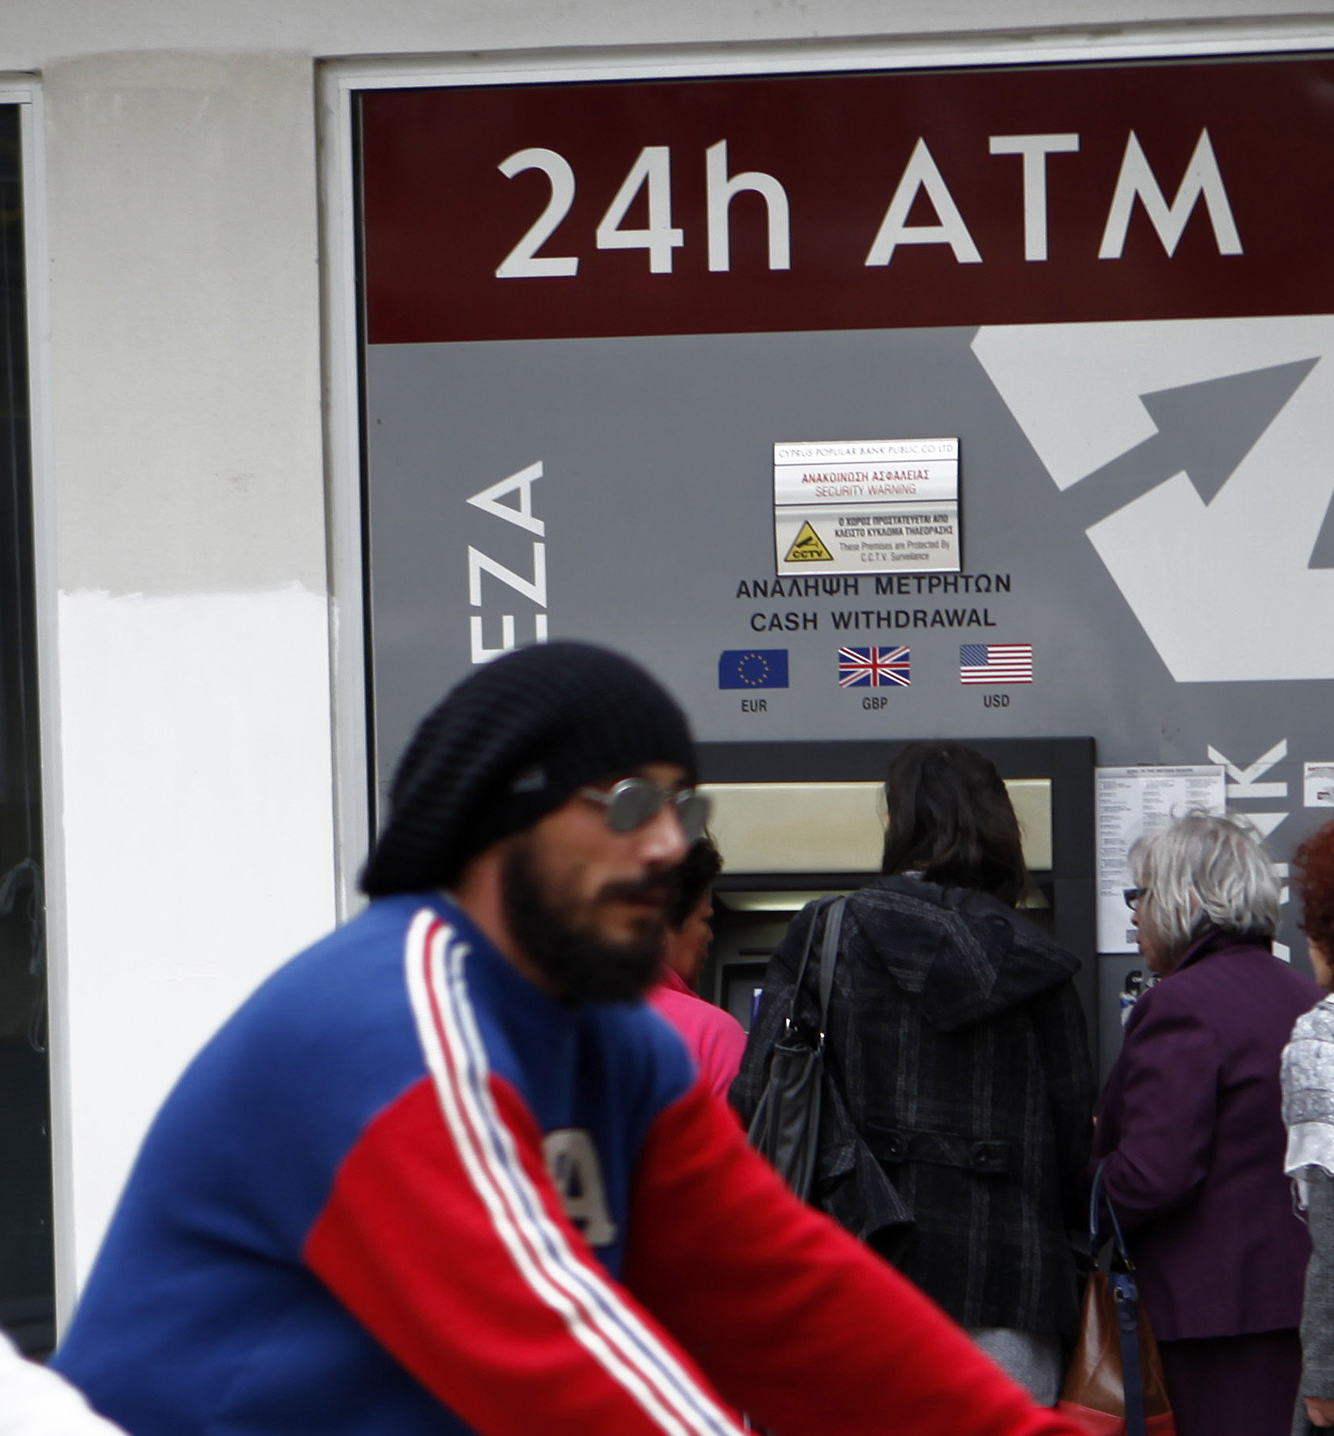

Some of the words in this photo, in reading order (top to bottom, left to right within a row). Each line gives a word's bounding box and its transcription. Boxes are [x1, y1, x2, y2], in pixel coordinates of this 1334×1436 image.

[496, 140, 790, 279] 24h
[865, 129, 1244, 267] ATM
[860, 446, 886, 456] BANK
[815, 485, 865, 498] SECURITY
[868, 483, 917, 496] WARNING
[793, 551, 824, 559] CCTV
[736, 576, 860, 598] ΑΝΑΛΗΨΗ
[875, 574, 1011, 595] ΜΕΤΡΗΤΩΝ
[750, 612, 818, 632] CASH
[831, 608, 997, 630] WITHDRAWAL
[741, 699, 768, 712] EUR
[862, 697, 888, 710] GBP
[983, 694, 1010, 708] USD
